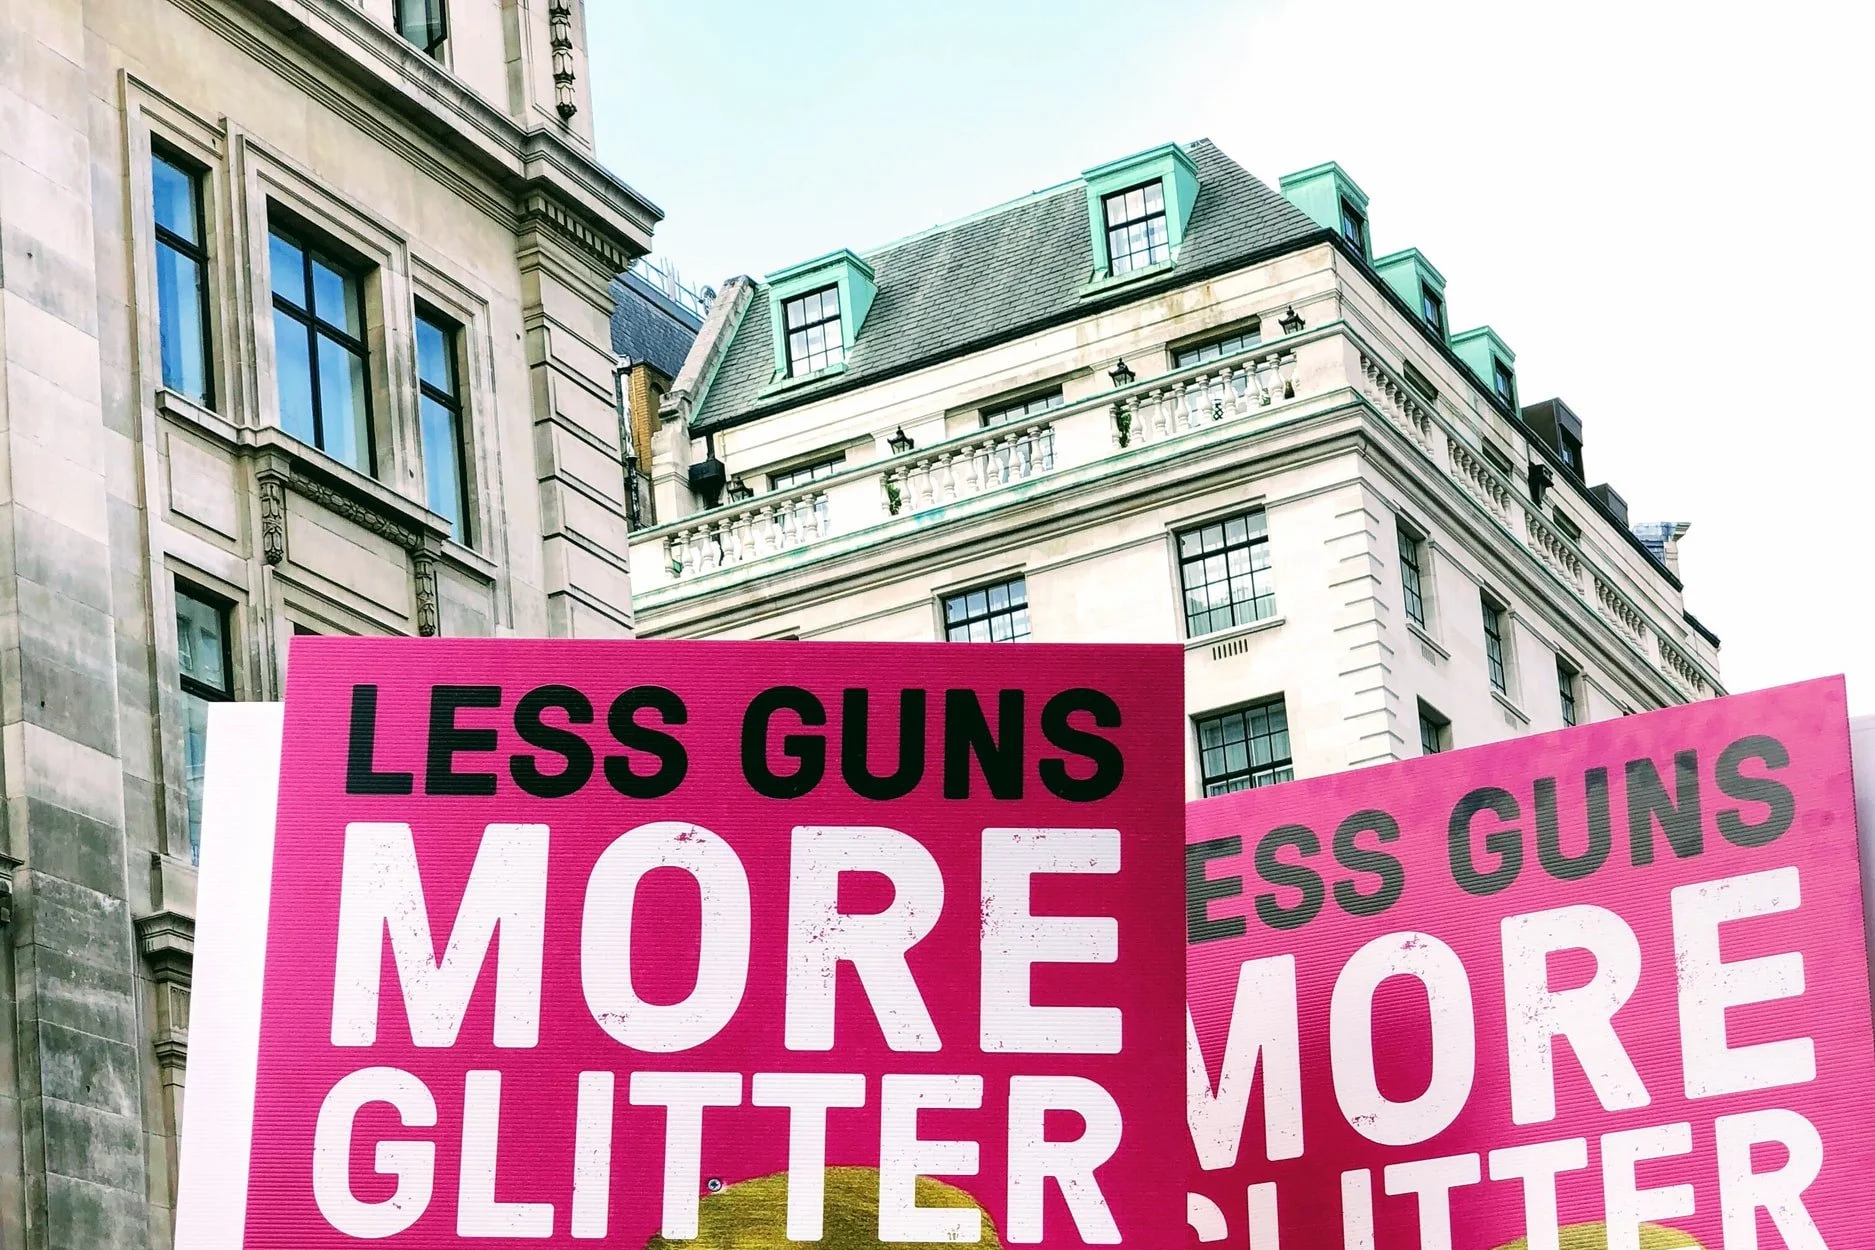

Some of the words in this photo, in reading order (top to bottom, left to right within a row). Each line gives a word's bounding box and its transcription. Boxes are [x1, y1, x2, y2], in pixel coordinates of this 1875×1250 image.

[345, 684, 689, 799] LESS
[741, 686, 1125, 802] GUNS
[1447, 733, 1797, 897] GUNS
[330, 820, 1123, 1055] MORE
[1186, 865, 1817, 1171] MORE
[312, 1066, 1124, 1244] GLITTER
